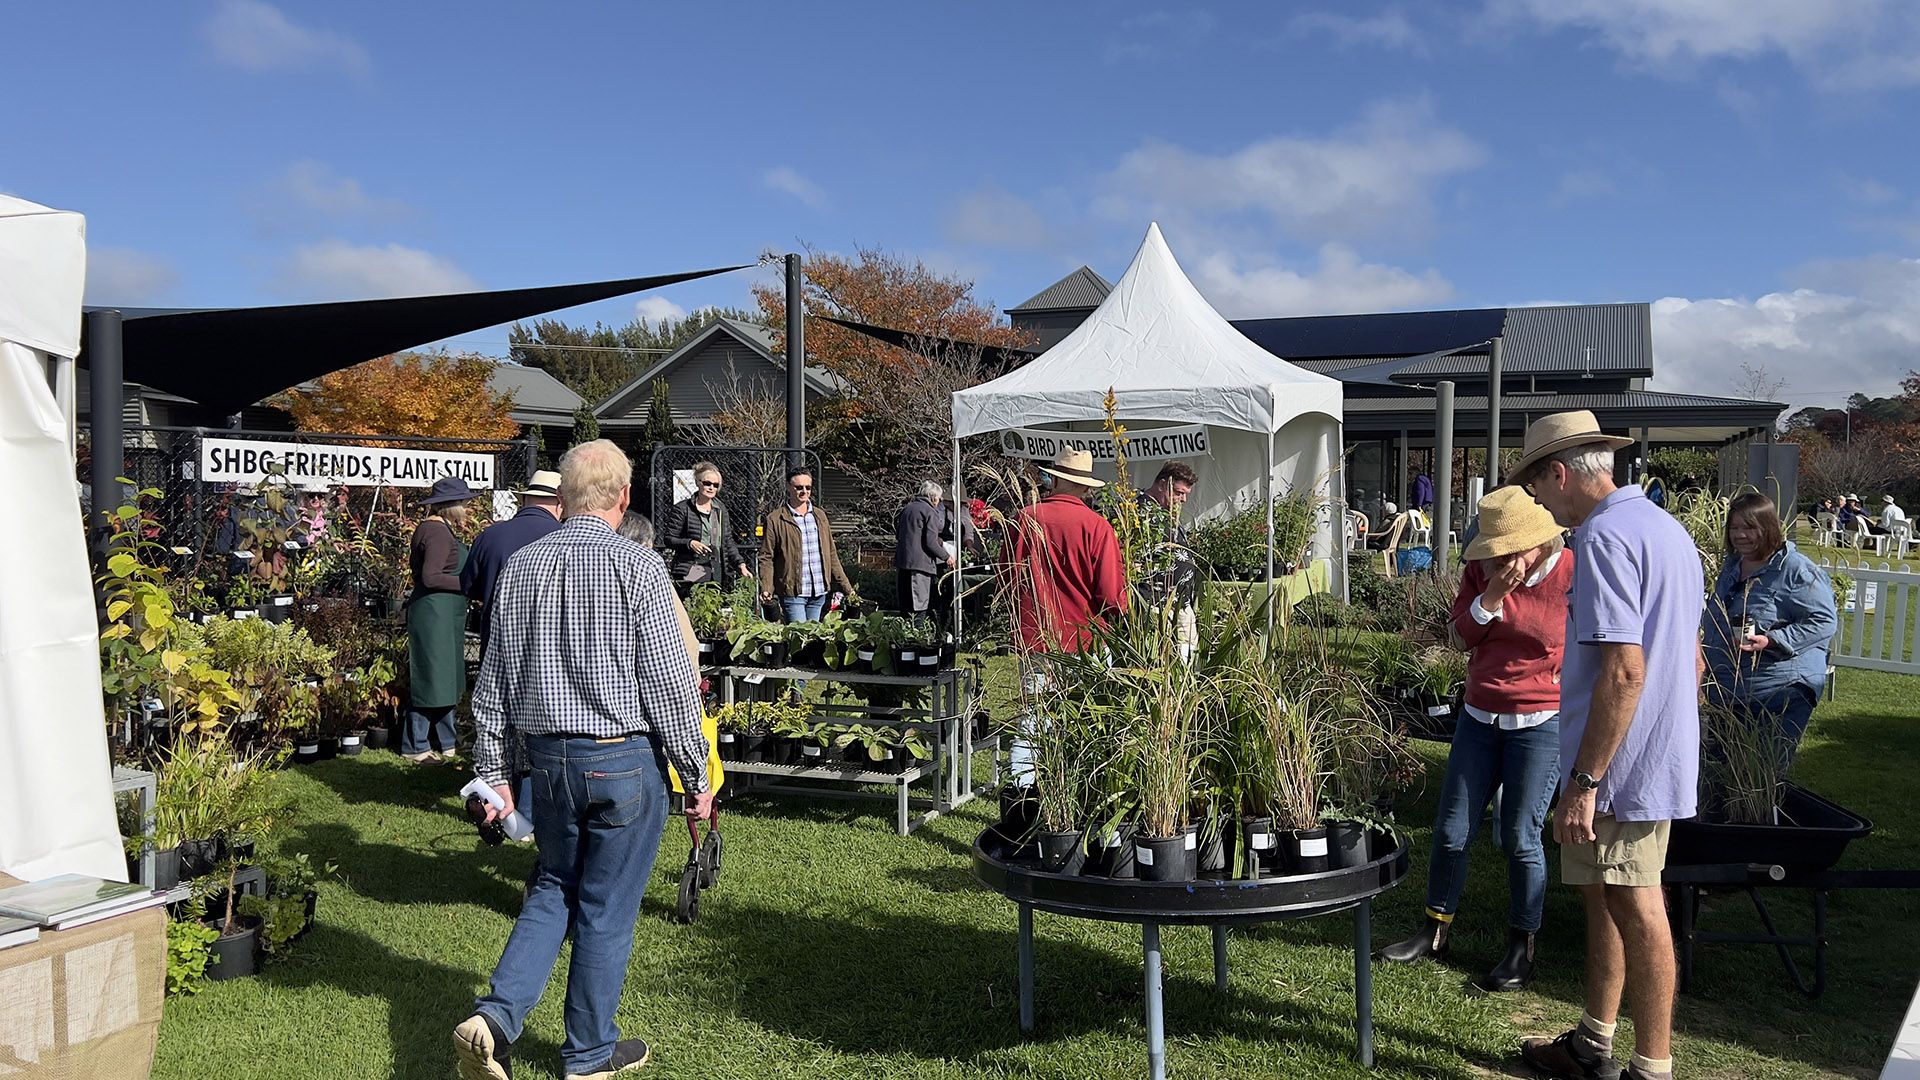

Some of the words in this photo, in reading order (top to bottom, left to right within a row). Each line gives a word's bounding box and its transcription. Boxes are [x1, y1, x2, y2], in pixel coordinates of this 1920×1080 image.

[1026, 436, 1056, 457] BIRD
[1088, 439, 1114, 459] BEE
[1118, 432, 1206, 457] ATTRACTING
[284, 452, 372, 478] FRIENDS
[380, 456, 438, 480] PLANT
[444, 459, 489, 481] STALL
